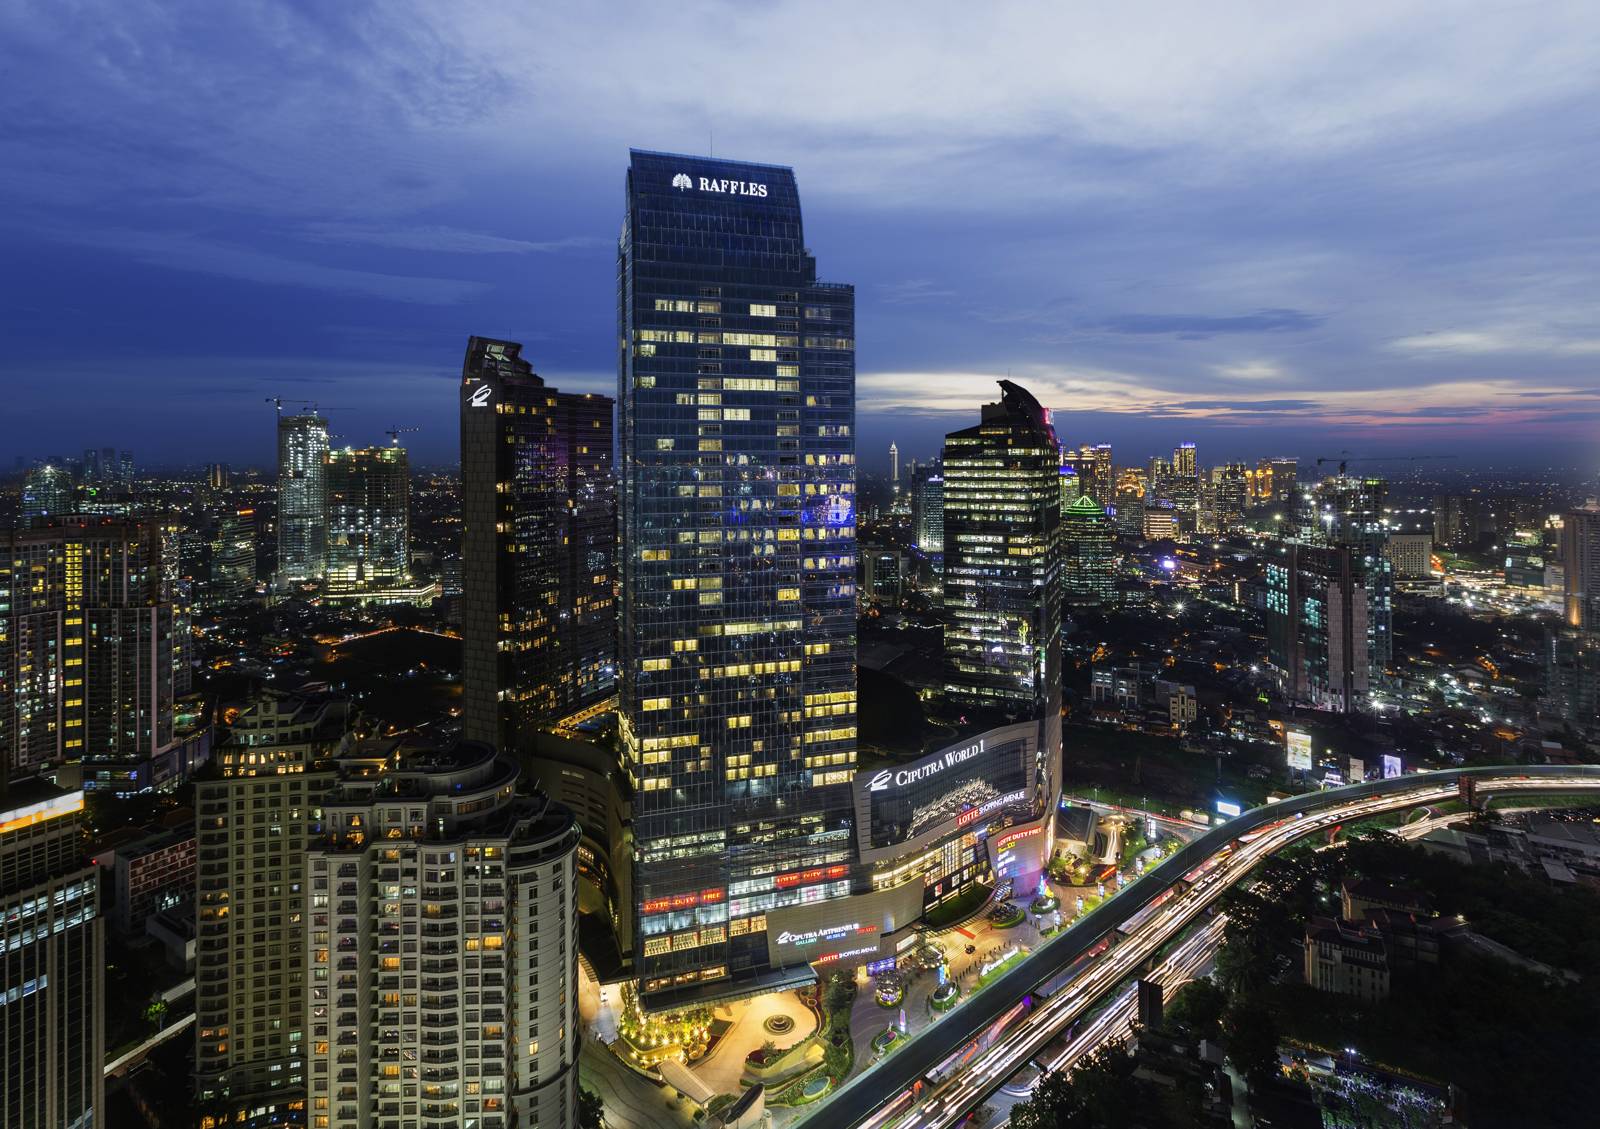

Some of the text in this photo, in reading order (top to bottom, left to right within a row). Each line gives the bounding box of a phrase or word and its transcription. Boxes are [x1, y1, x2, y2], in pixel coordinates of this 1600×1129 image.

[699, 177, 768, 197] RAFFLES
[895, 760, 945, 786] CIPUTRA
[958, 791, 1025, 825] LOTTE SHOPPING AVENUE
[1012, 831, 1028, 841] DUTY
[820, 954, 838, 962] LOTTE
